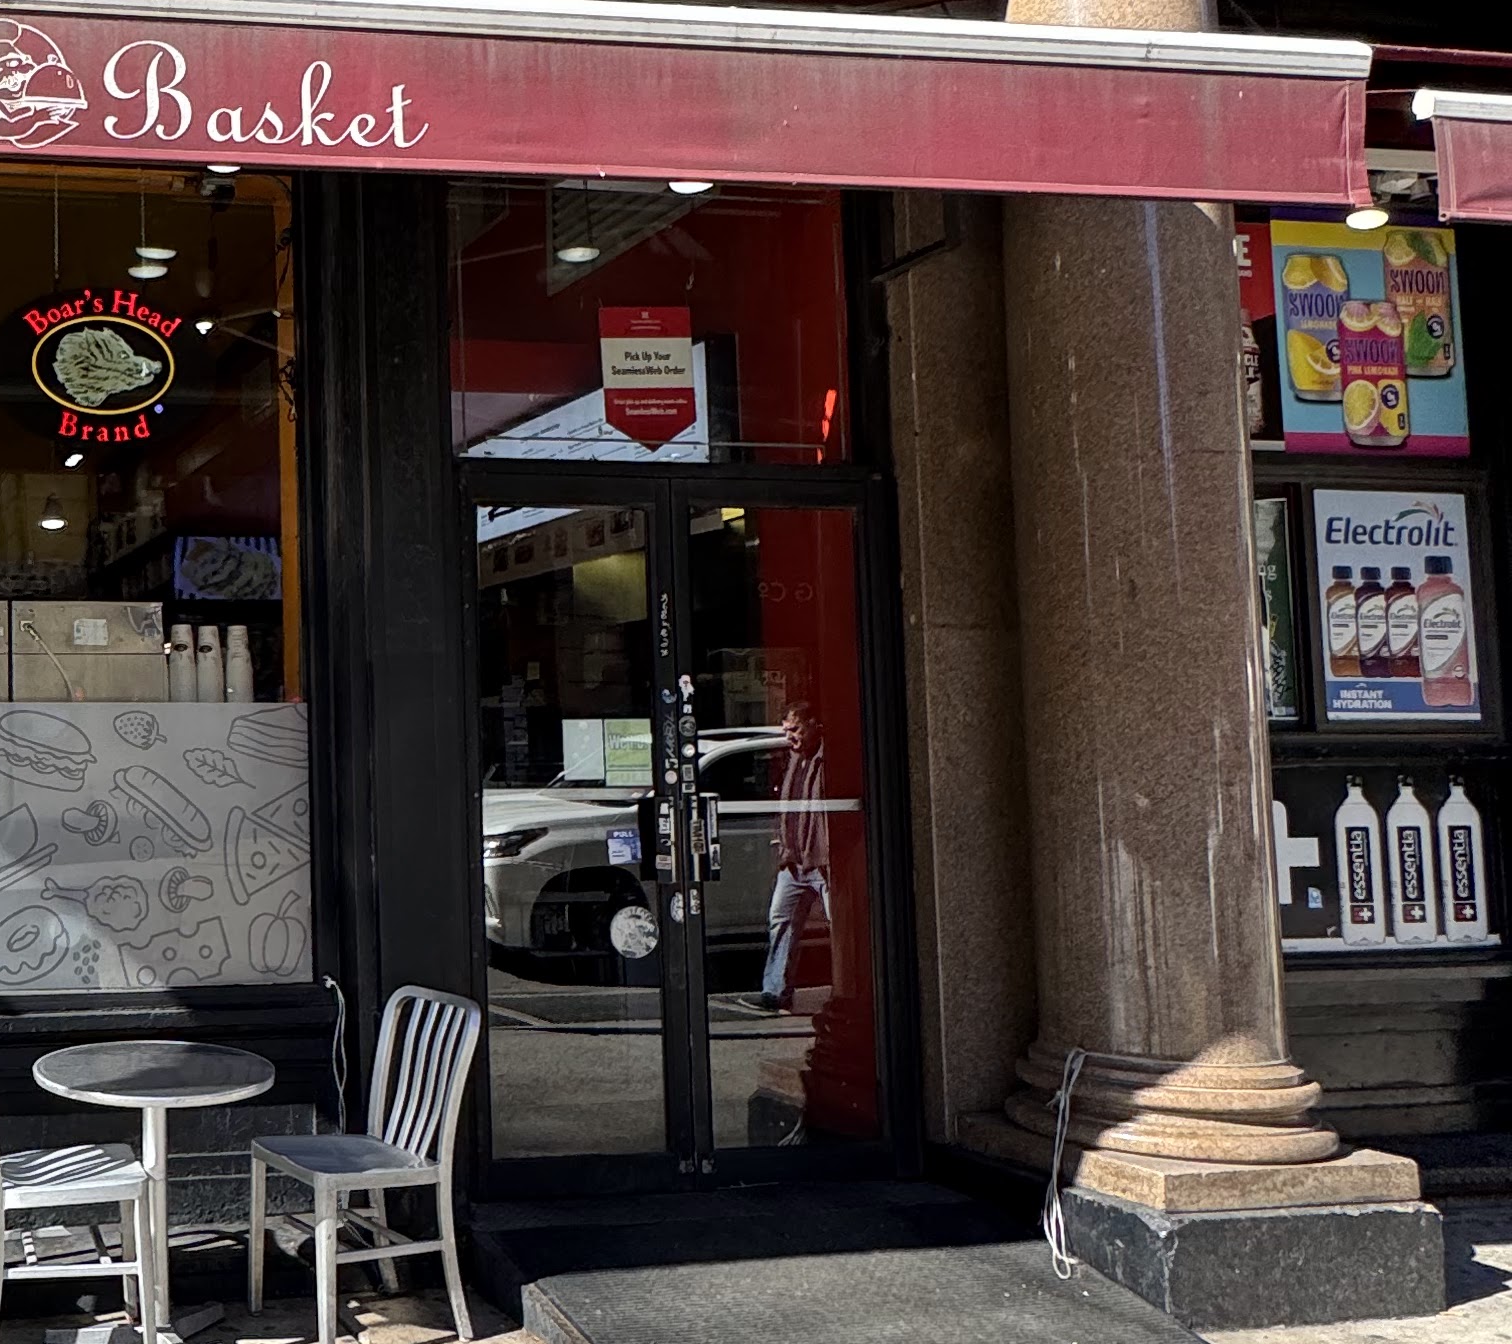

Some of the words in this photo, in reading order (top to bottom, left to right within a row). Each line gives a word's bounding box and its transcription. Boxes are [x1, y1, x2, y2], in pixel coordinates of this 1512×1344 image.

[102, 39, 428, 148] Basket
[22, 289, 103, 336] Boar's
[111, 290, 182, 337] Head
[624, 351, 640, 361] Pick
[641, 351, 652, 363] Up
[653, 351, 671, 361] Your
[664, 365, 686, 376] Order
[58, 411, 150, 442] Brand
[1325, 515, 1456, 547] Electrolit
[1349, 829, 1367, 900] essentia
[1402, 828, 1418, 899] essentia
[1453, 828, 1470, 898] essentia
